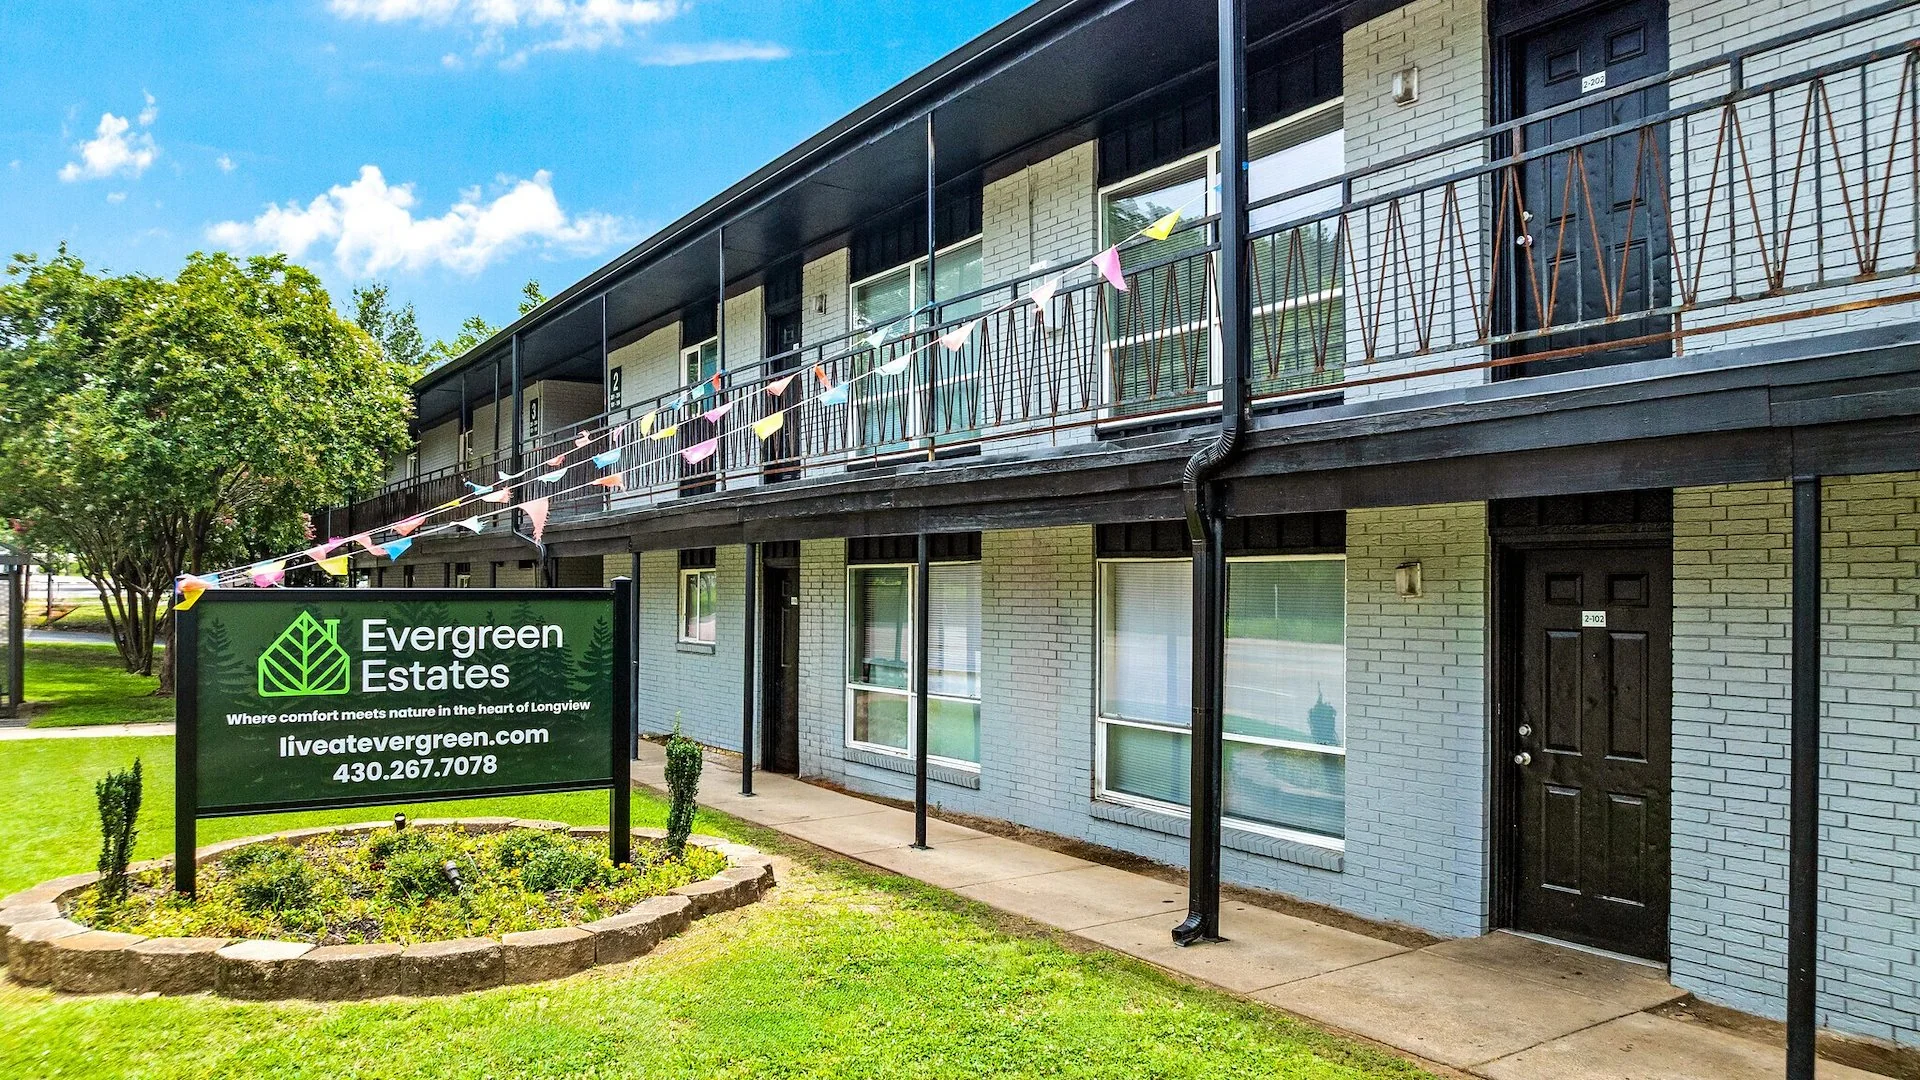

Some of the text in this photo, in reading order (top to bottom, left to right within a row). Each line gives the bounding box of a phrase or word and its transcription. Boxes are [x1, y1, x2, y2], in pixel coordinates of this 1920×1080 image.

[1583, 75, 1605, 89] 2-202
[613, 371, 619, 392] 2
[531, 402, 537, 420] 3
[1584, 614, 1605, 623] 2-102
[362, 617, 564, 659] Evergreen
[362, 658, 510, 694] Estates
[226, 699, 591, 726] Where comfort meets nature in the heart of Longview
[279, 727, 550, 759] liveatevergreen.com
[332, 754, 498, 784] 430.267.7078
